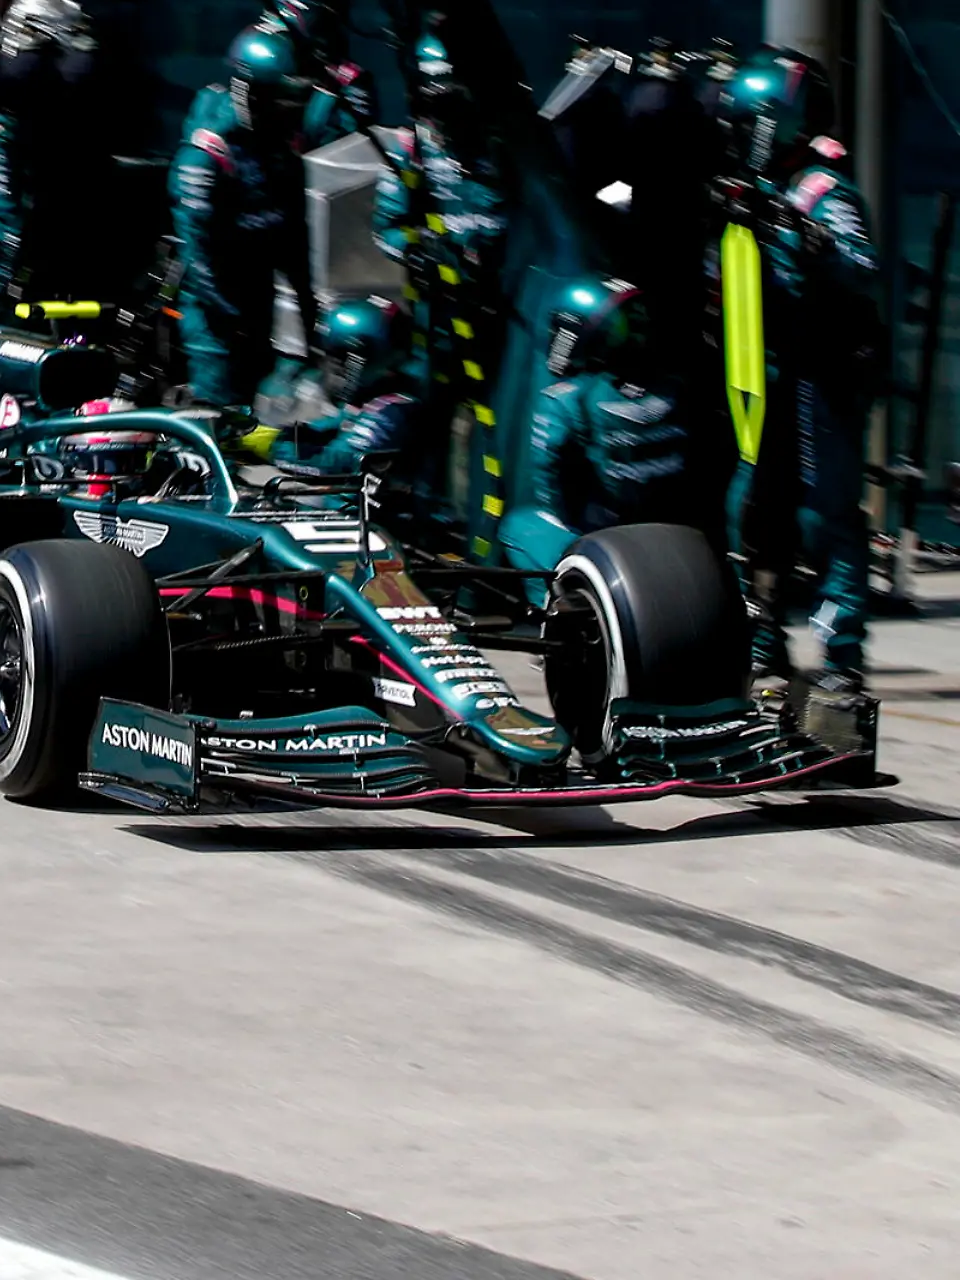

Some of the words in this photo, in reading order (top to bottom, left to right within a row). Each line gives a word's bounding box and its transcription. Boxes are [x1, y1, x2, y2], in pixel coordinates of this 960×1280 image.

[281, 520, 388, 554] 5
[375, 606, 442, 620] BWT
[102, 722, 150, 753] ASTON
[151, 733, 192, 766] MARTIN
[285, 733, 387, 751] MARTIN
